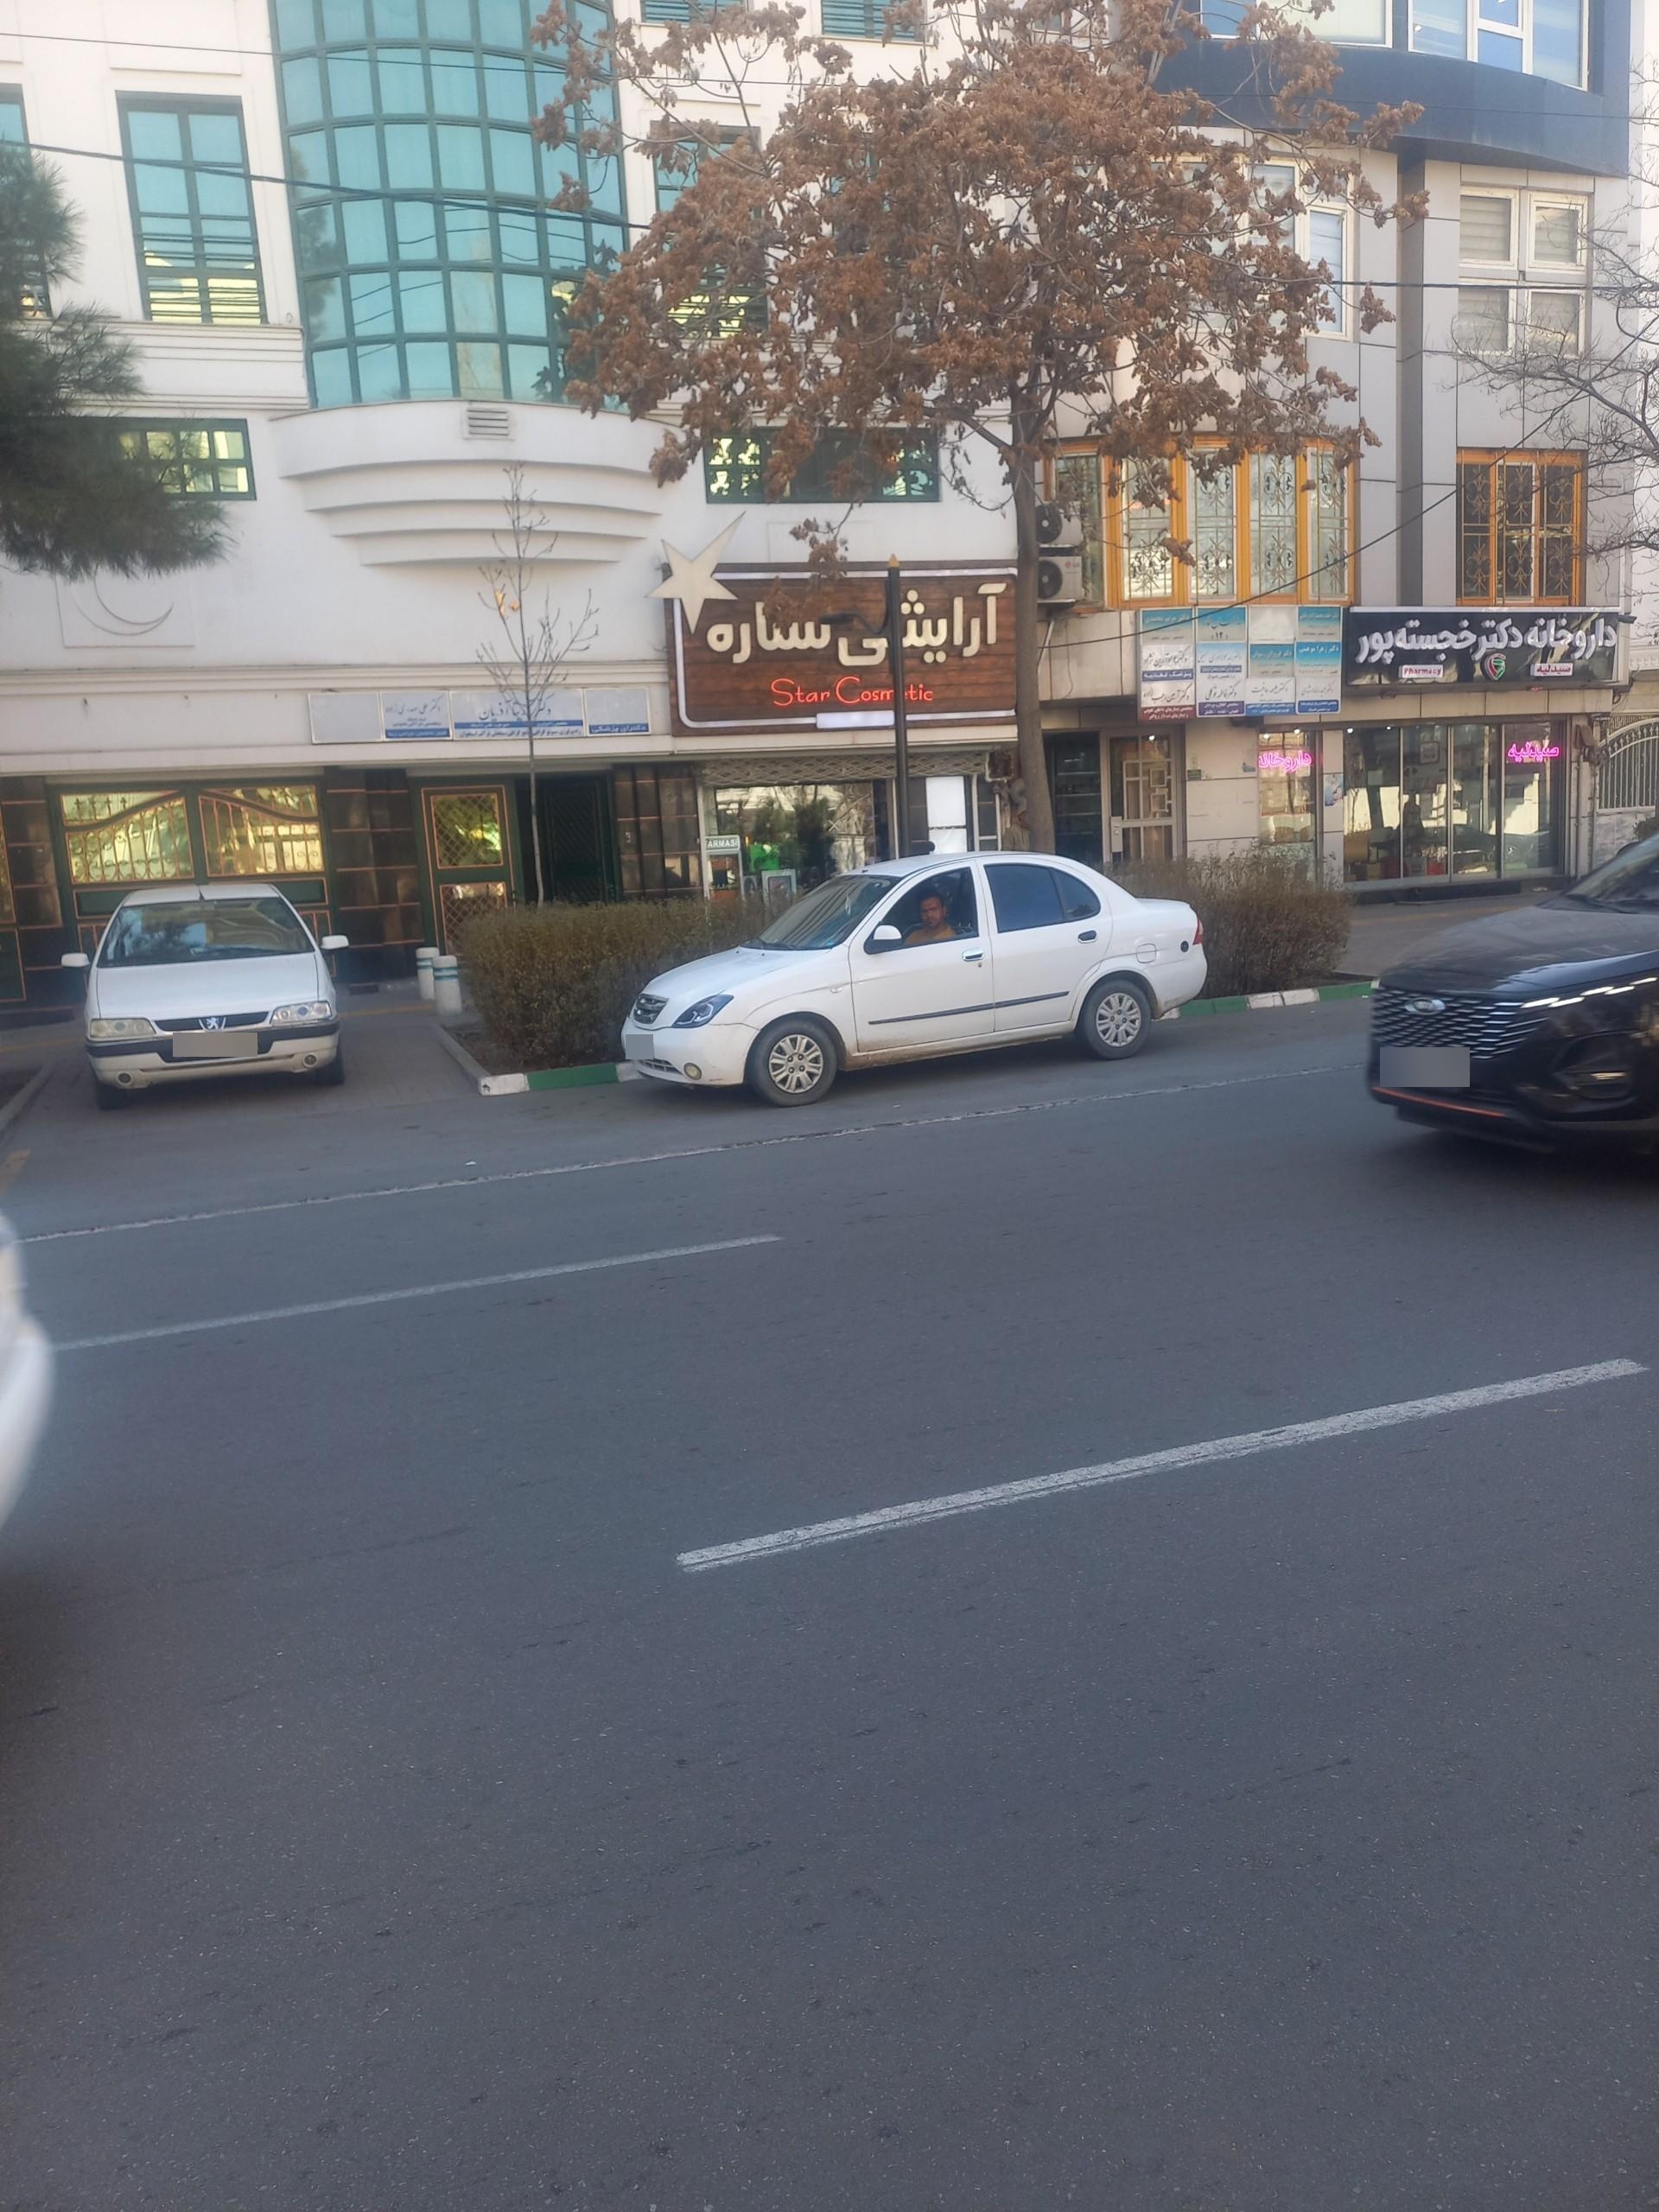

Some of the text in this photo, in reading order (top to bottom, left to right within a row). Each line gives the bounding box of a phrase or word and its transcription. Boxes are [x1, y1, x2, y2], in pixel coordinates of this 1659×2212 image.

[837, 582, 1007, 666] آرایشی
[1471, 617, 1522, 662] دکتر
[1524, 617, 1617, 660] داروخانه
[1403, 667, 1442, 677] Pharmacy
[770, 676, 934, 707] Star Cosmtic
[1258, 751, 1312, 773] داروخانه
